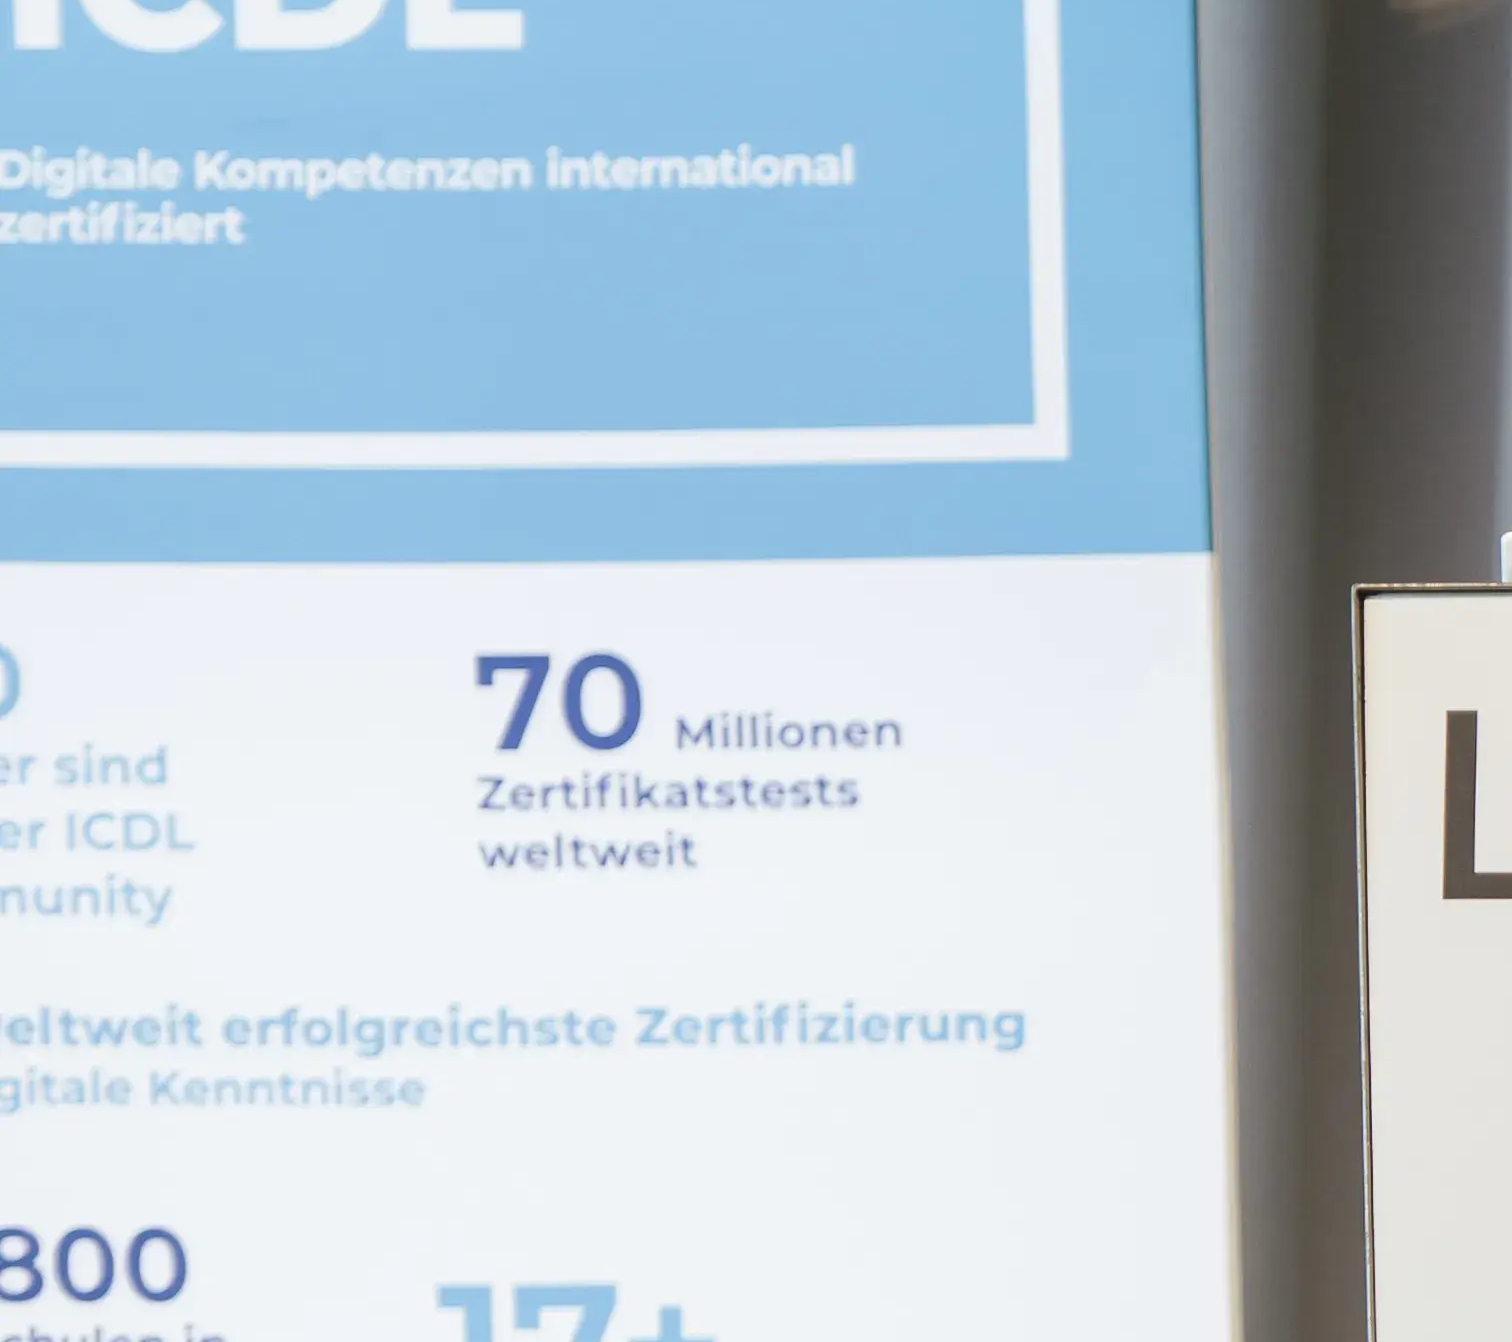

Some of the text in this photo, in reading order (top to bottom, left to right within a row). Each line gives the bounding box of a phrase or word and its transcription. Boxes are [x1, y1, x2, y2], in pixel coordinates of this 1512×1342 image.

[0, 143, 856, 200] Digitale Kompetenzen international
[0, 201, 245, 244] zertifiziert
[474, 651, 904, 751] 70 Millionen
[53, 742, 168, 786] sind
[476, 769, 861, 812] Zertifikatstests
[66, 811, 197, 851] ICDL
[479, 829, 699, 871] weltweit
[0, 999, 1029, 1057] eltweit erfolgreichste Zertifizierung
[149, 1066, 427, 1107] Kenntnisse
